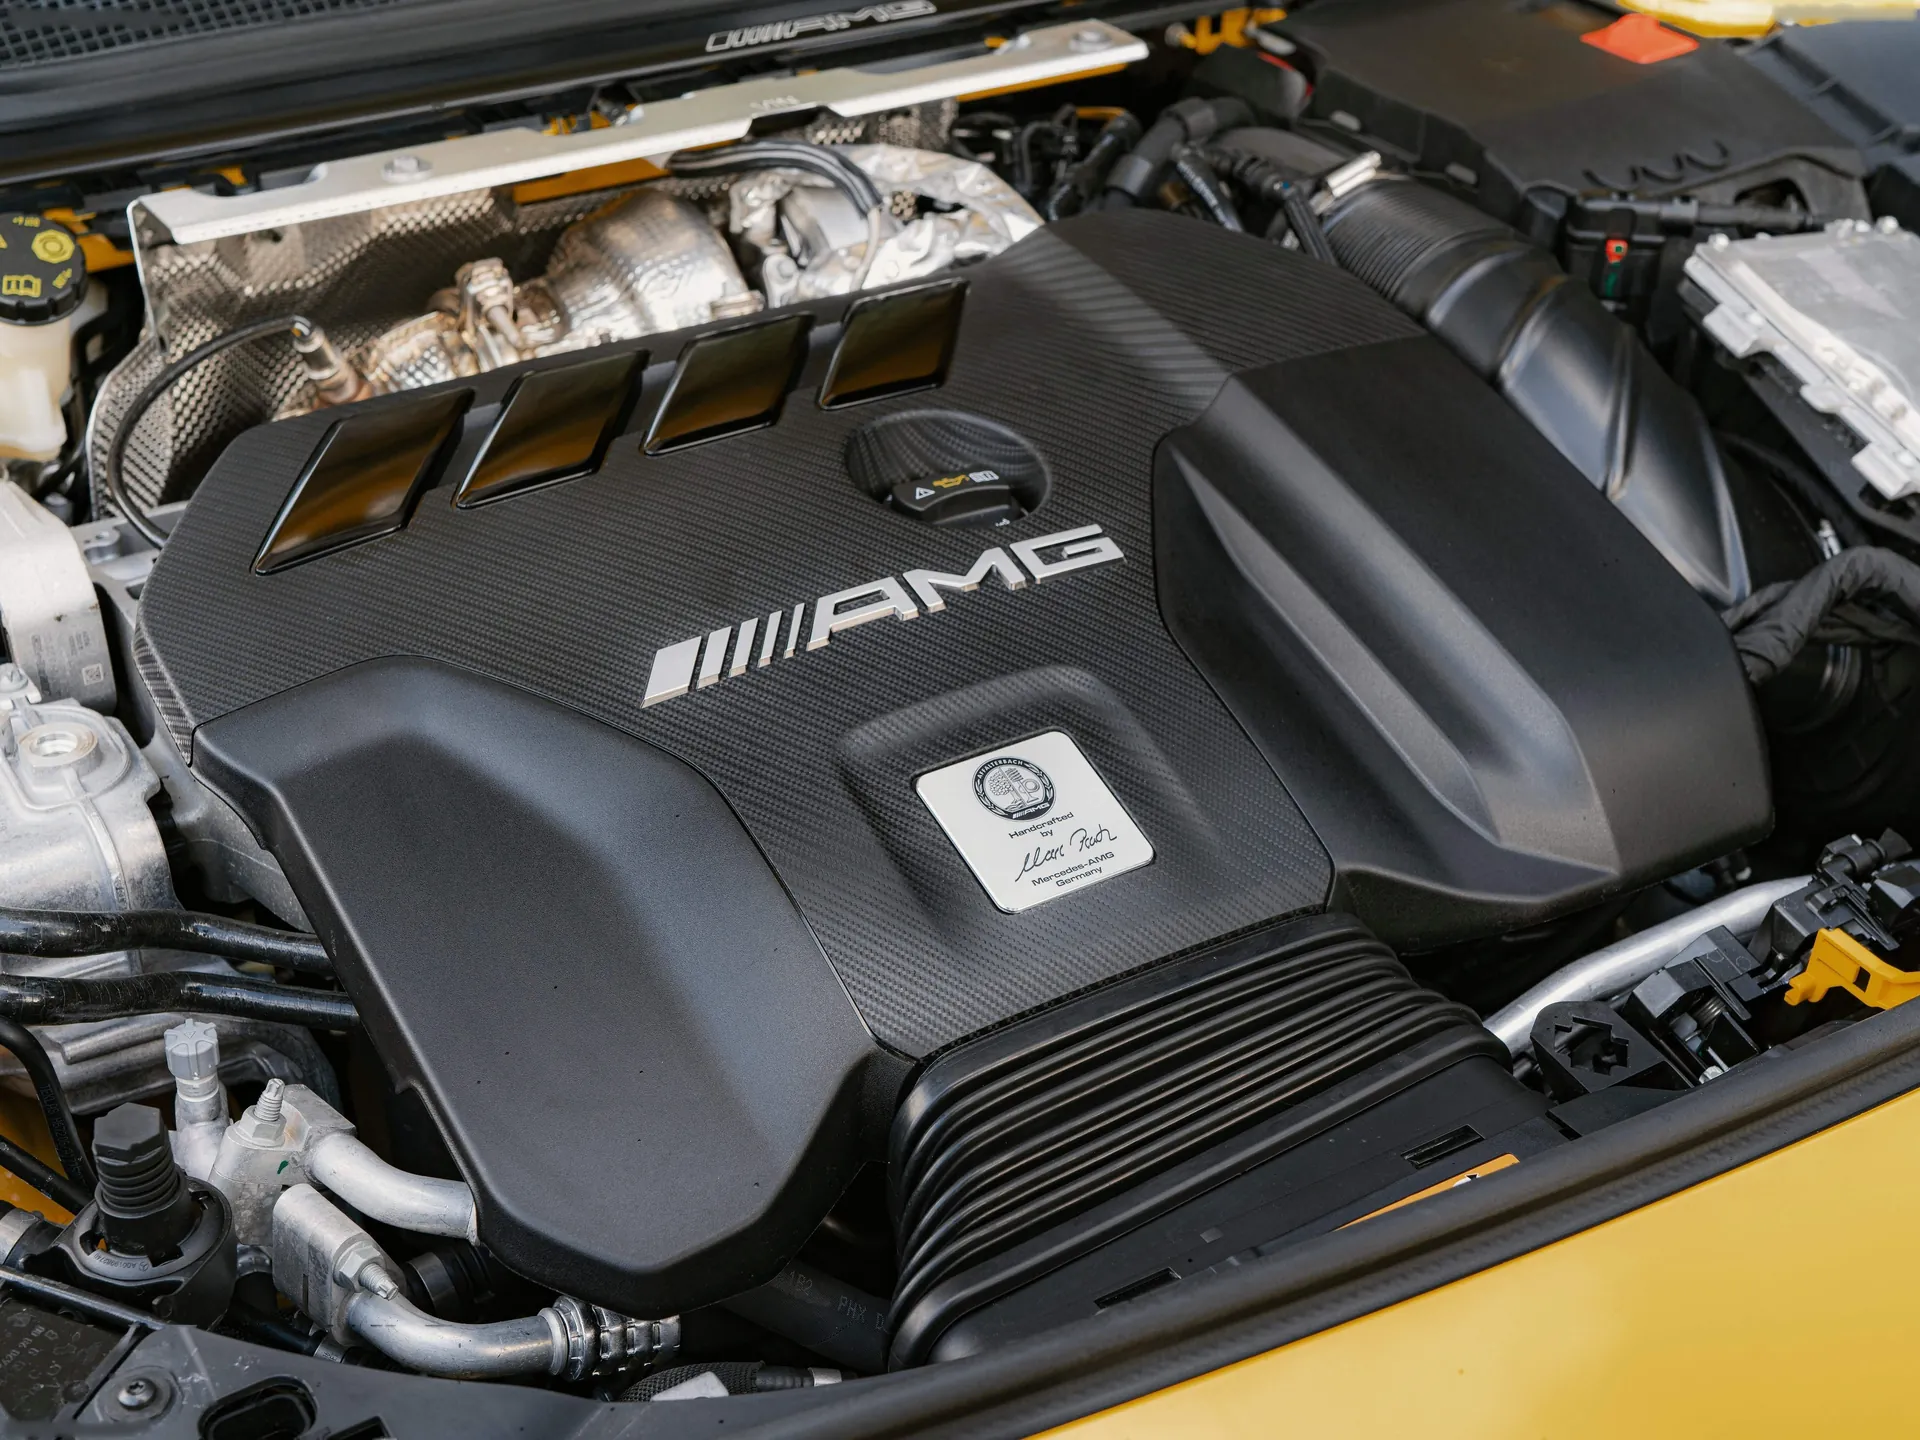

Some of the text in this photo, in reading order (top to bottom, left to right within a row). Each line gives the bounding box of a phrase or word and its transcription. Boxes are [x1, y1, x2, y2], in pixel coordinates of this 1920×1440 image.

[976, 759, 1023, 779] AFFALTERBACH
[1008, 811, 1074, 839] Handcrafted
[1040, 829, 1054, 838] by
[1031, 851, 1115, 887] Mercedes-AMG
[1056, 866, 1103, 887] Germany
